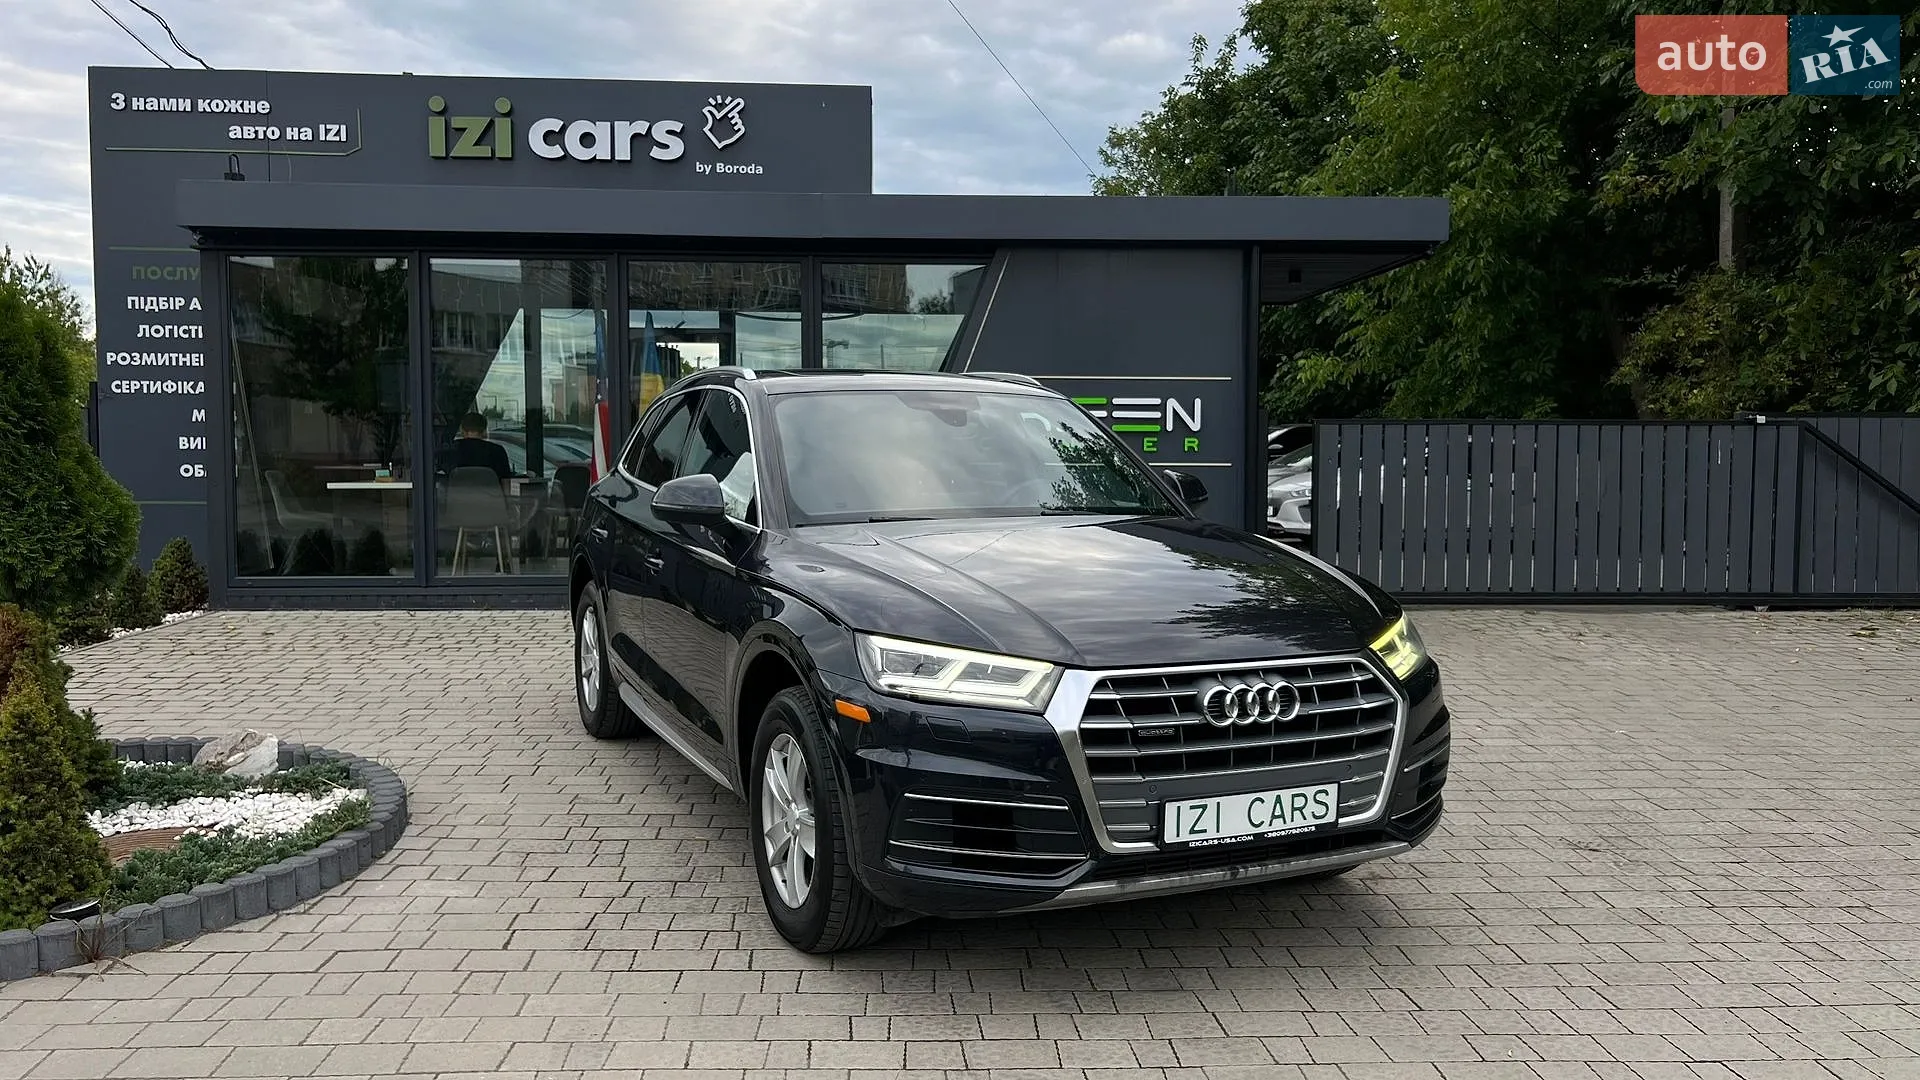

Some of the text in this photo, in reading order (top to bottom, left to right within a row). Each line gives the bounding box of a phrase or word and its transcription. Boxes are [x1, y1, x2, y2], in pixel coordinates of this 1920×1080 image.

[110, 92, 270, 114] З нами кожне
[228, 124, 347, 142] авто на IZI
[428, 95, 685, 160] izi cars
[695, 161, 763, 175] by Boroda
[132, 265, 200, 281] ПОСЛУ
[127, 296, 202, 312] ПІДБІР А
[110, 380, 205, 395] СЕРТИФІКА
[179, 463, 207, 478] ОБ
[1175, 788, 1330, 838] IZI CARS
[1189, 834, 1254, 847] IZICARS-USA.COM
